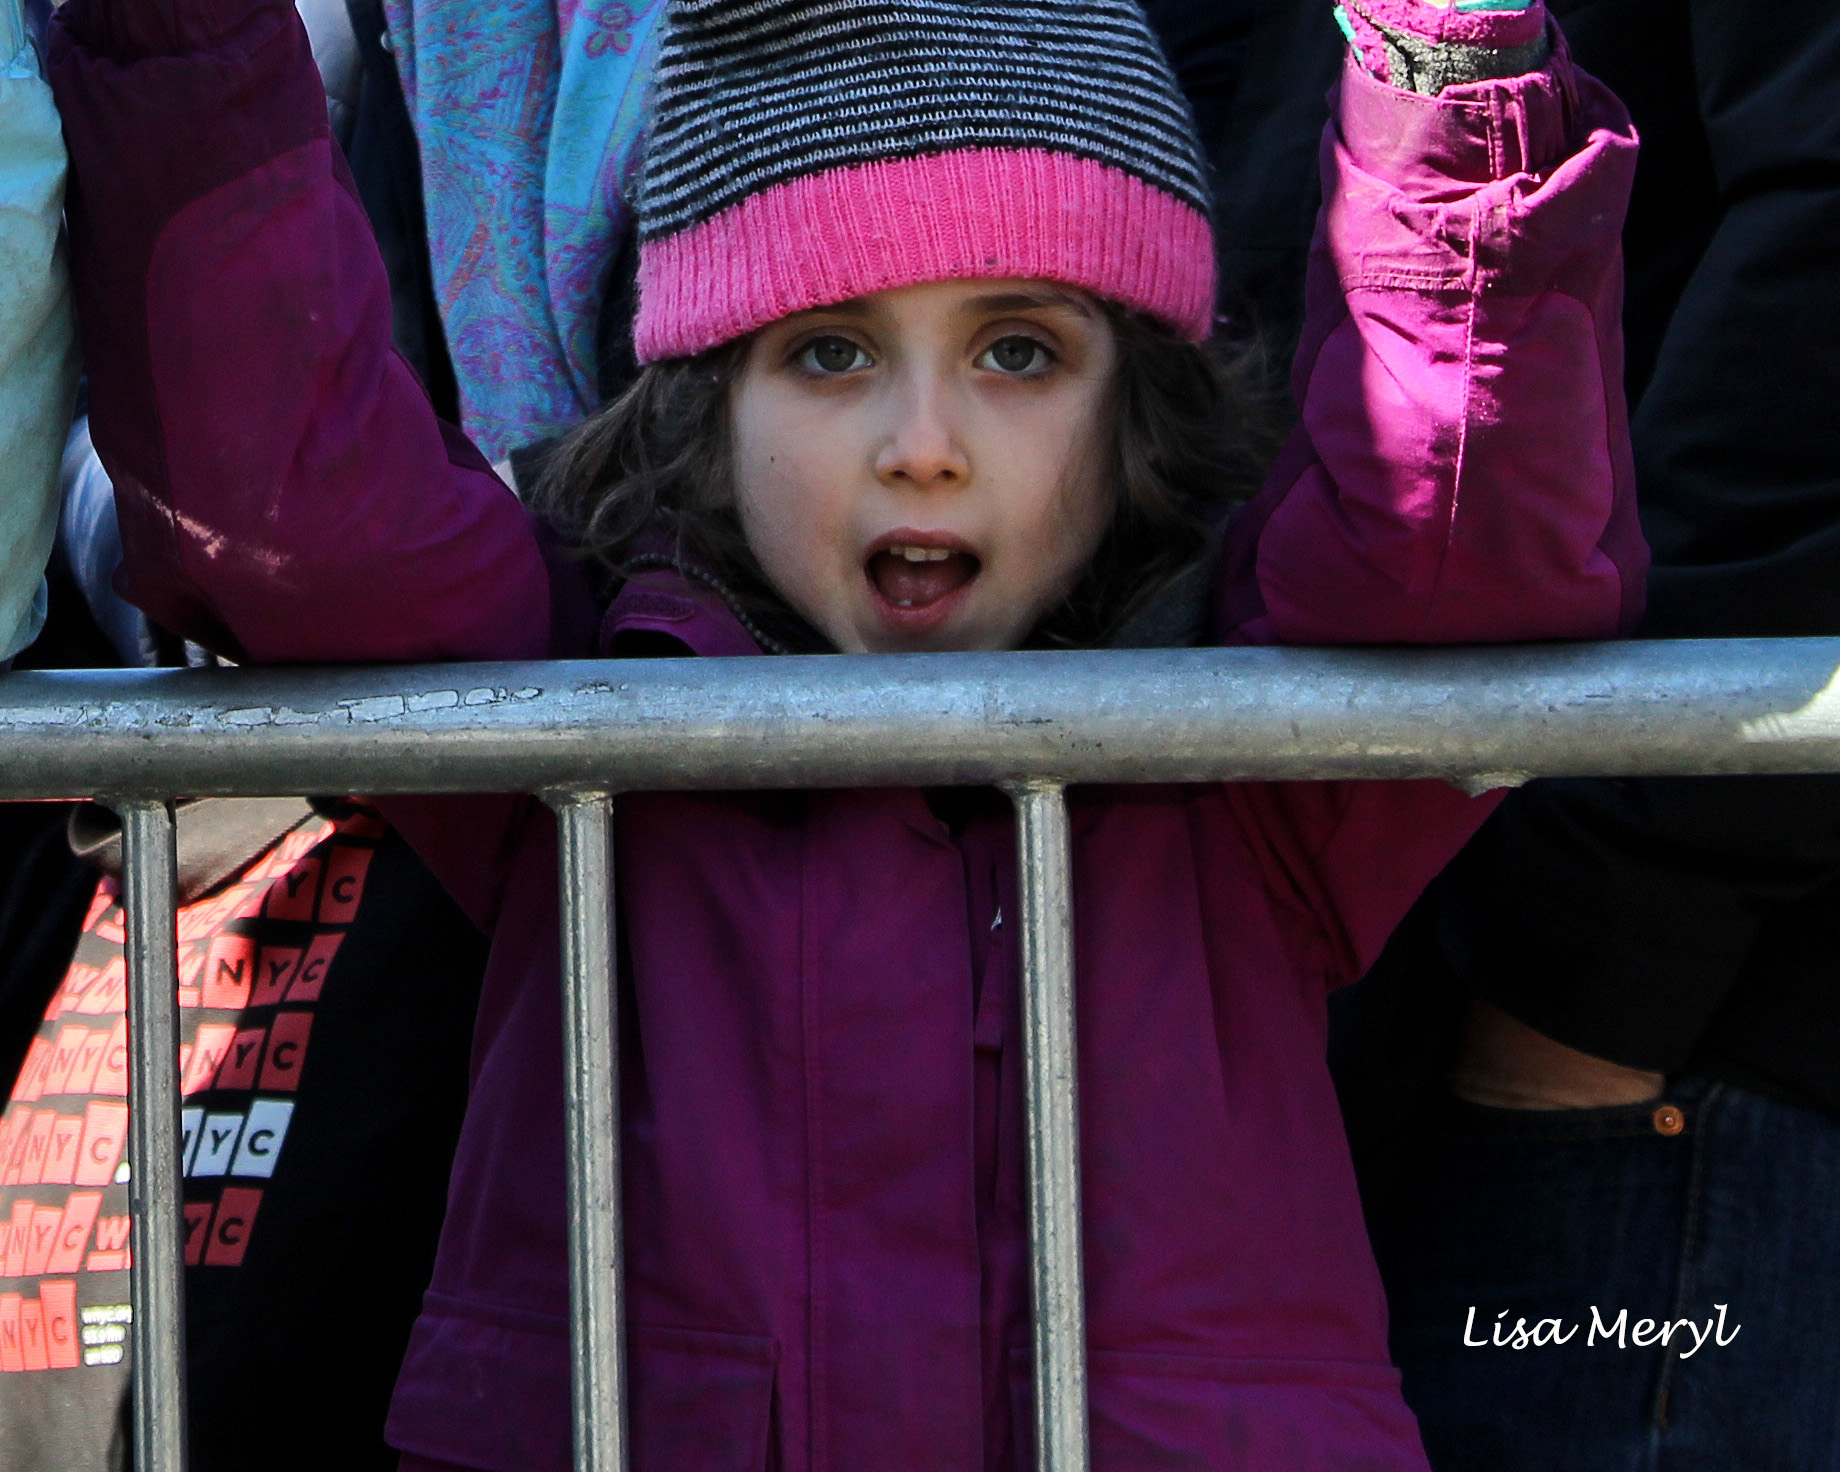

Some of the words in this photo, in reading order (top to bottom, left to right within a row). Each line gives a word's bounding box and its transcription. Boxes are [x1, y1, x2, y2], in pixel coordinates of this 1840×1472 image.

[286, 870, 358, 904] YC
[196, 1041, 298, 1074] NYC
[182, 1129, 275, 1158] YC
